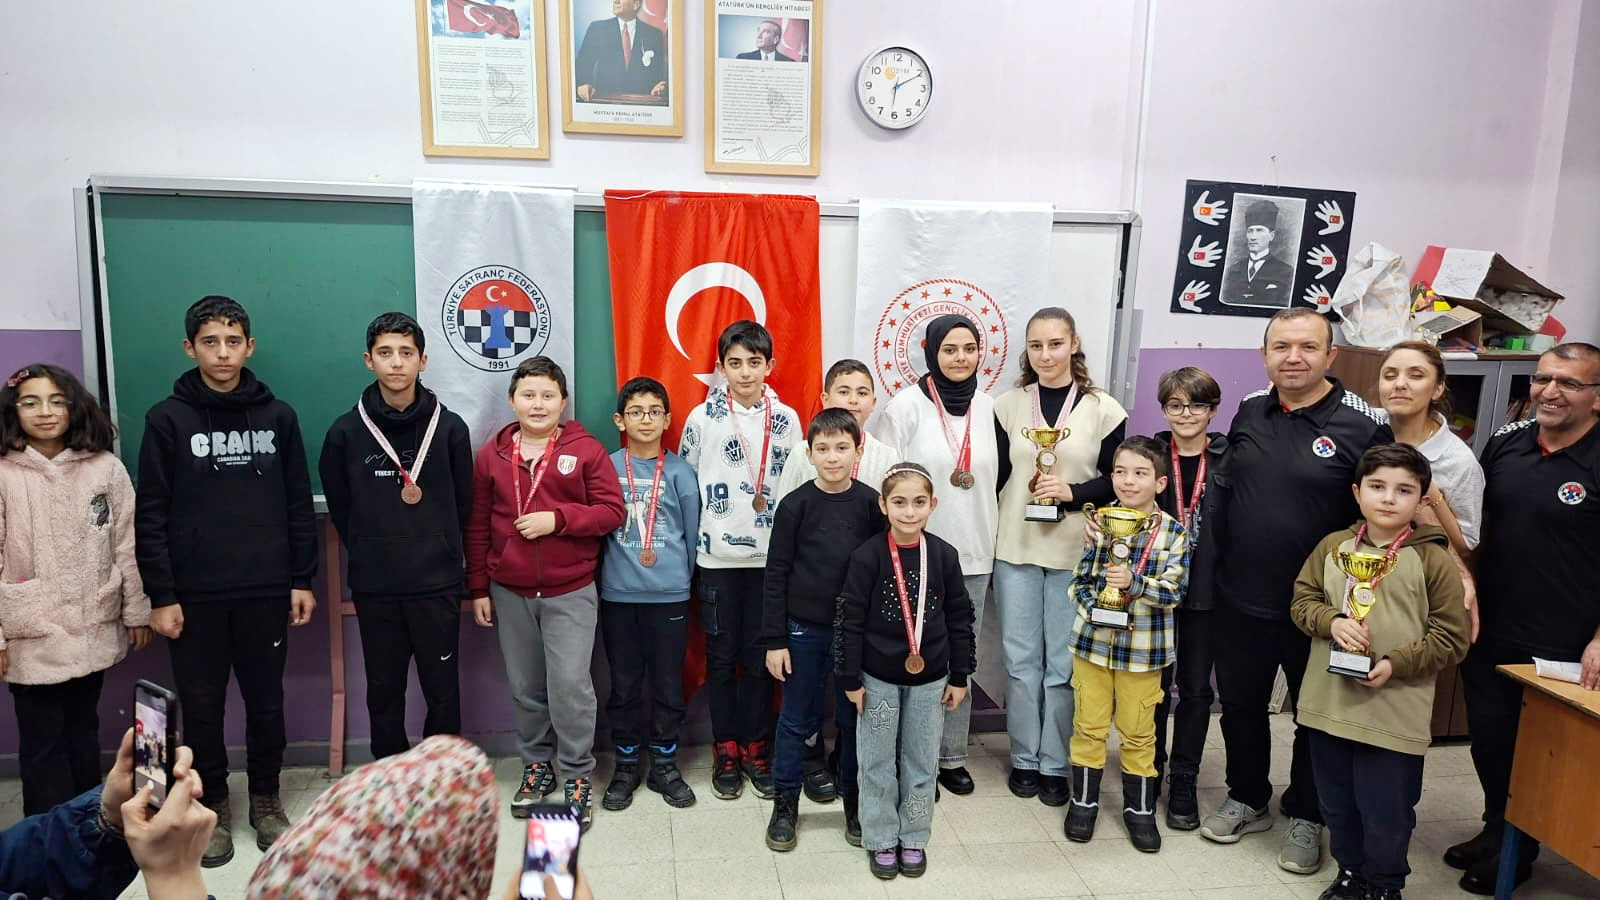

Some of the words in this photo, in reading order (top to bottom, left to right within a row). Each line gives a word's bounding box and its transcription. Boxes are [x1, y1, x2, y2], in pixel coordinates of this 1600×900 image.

[881, 56, 888, 66] 11
[894, 53, 903, 62] 12
[871, 66, 882, 75] 10
[916, 69, 924, 78] 2
[865, 81, 873, 90] 9
[919, 84, 927, 93] 3
[868, 96, 876, 105] 8
[914, 98, 921, 107] 4
[877, 106, 885, 115] 7
[905, 107, 912, 117] 5
[890, 111, 898, 120] 6
[446, 291, 461, 337] TÜRKİYE
[458, 269, 505, 292] SATRANÇ
[507, 271, 548, 339] FEDERASYONU
[898, 306, 931, 359] CUMHURİYETİ
[488, 360, 510, 369] 1991
[900, 361, 919, 385] RKİYE
